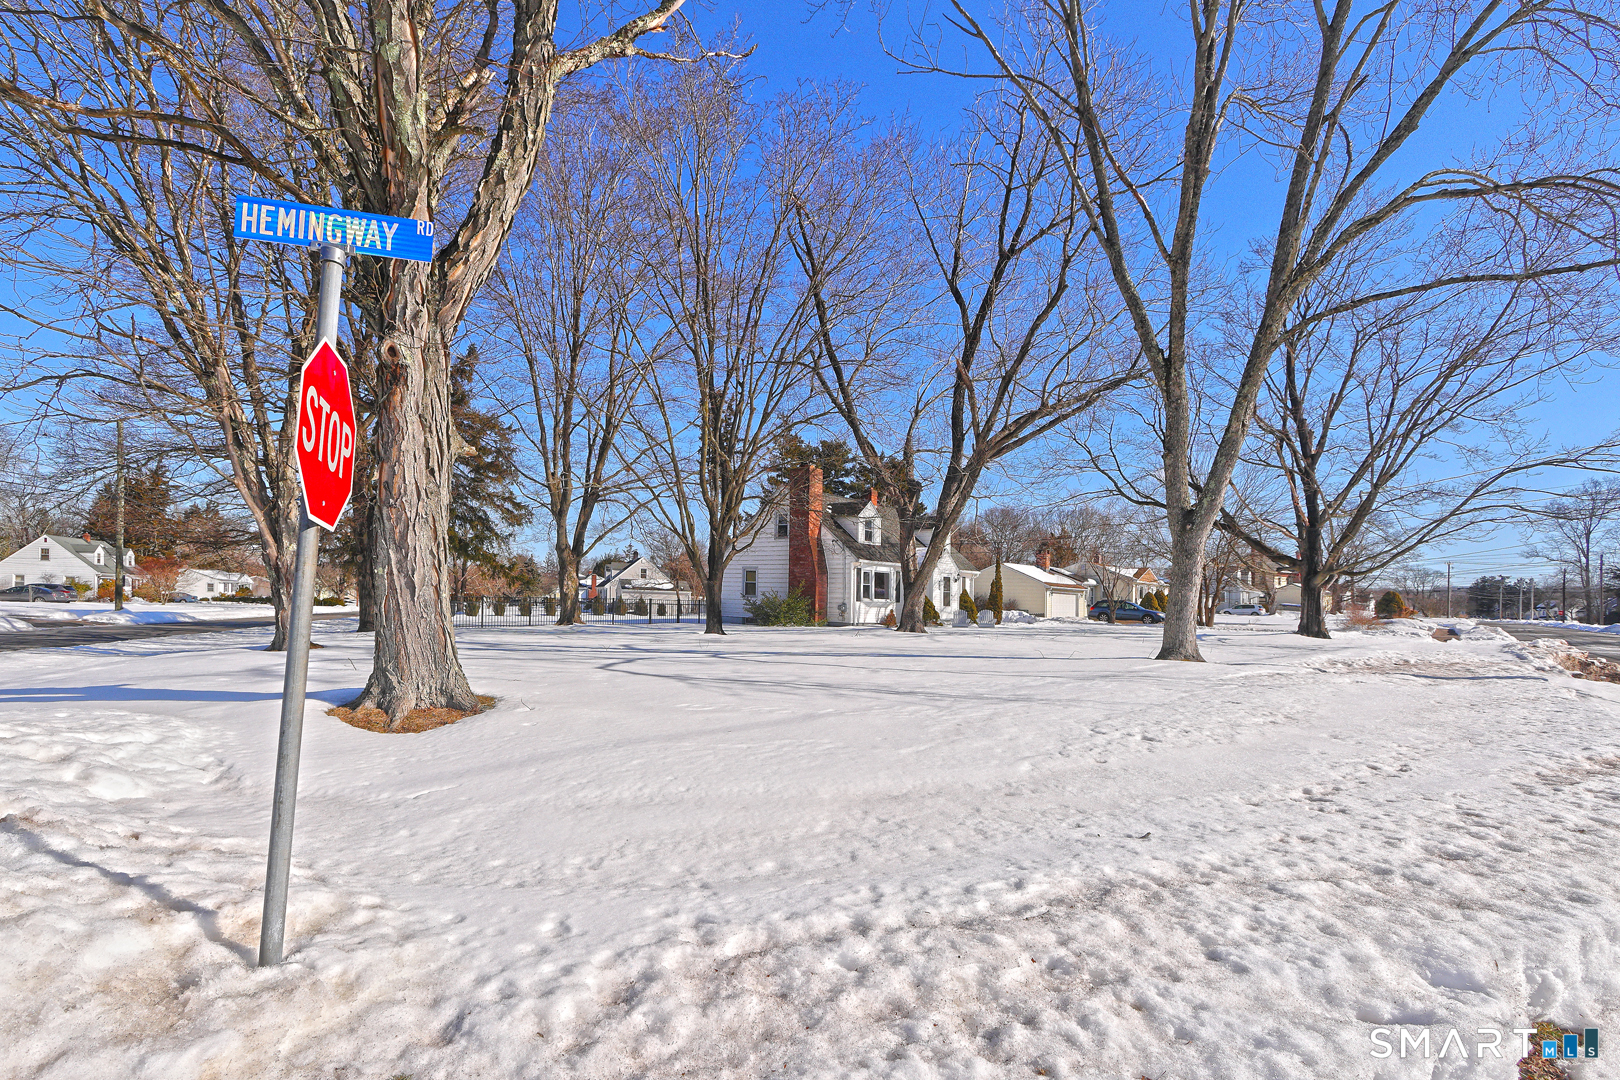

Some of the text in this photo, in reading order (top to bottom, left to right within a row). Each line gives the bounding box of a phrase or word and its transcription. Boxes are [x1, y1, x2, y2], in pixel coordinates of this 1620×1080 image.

[241, 202, 434, 251] HEMINGWAY RD
[302, 385, 352, 479] STOP
